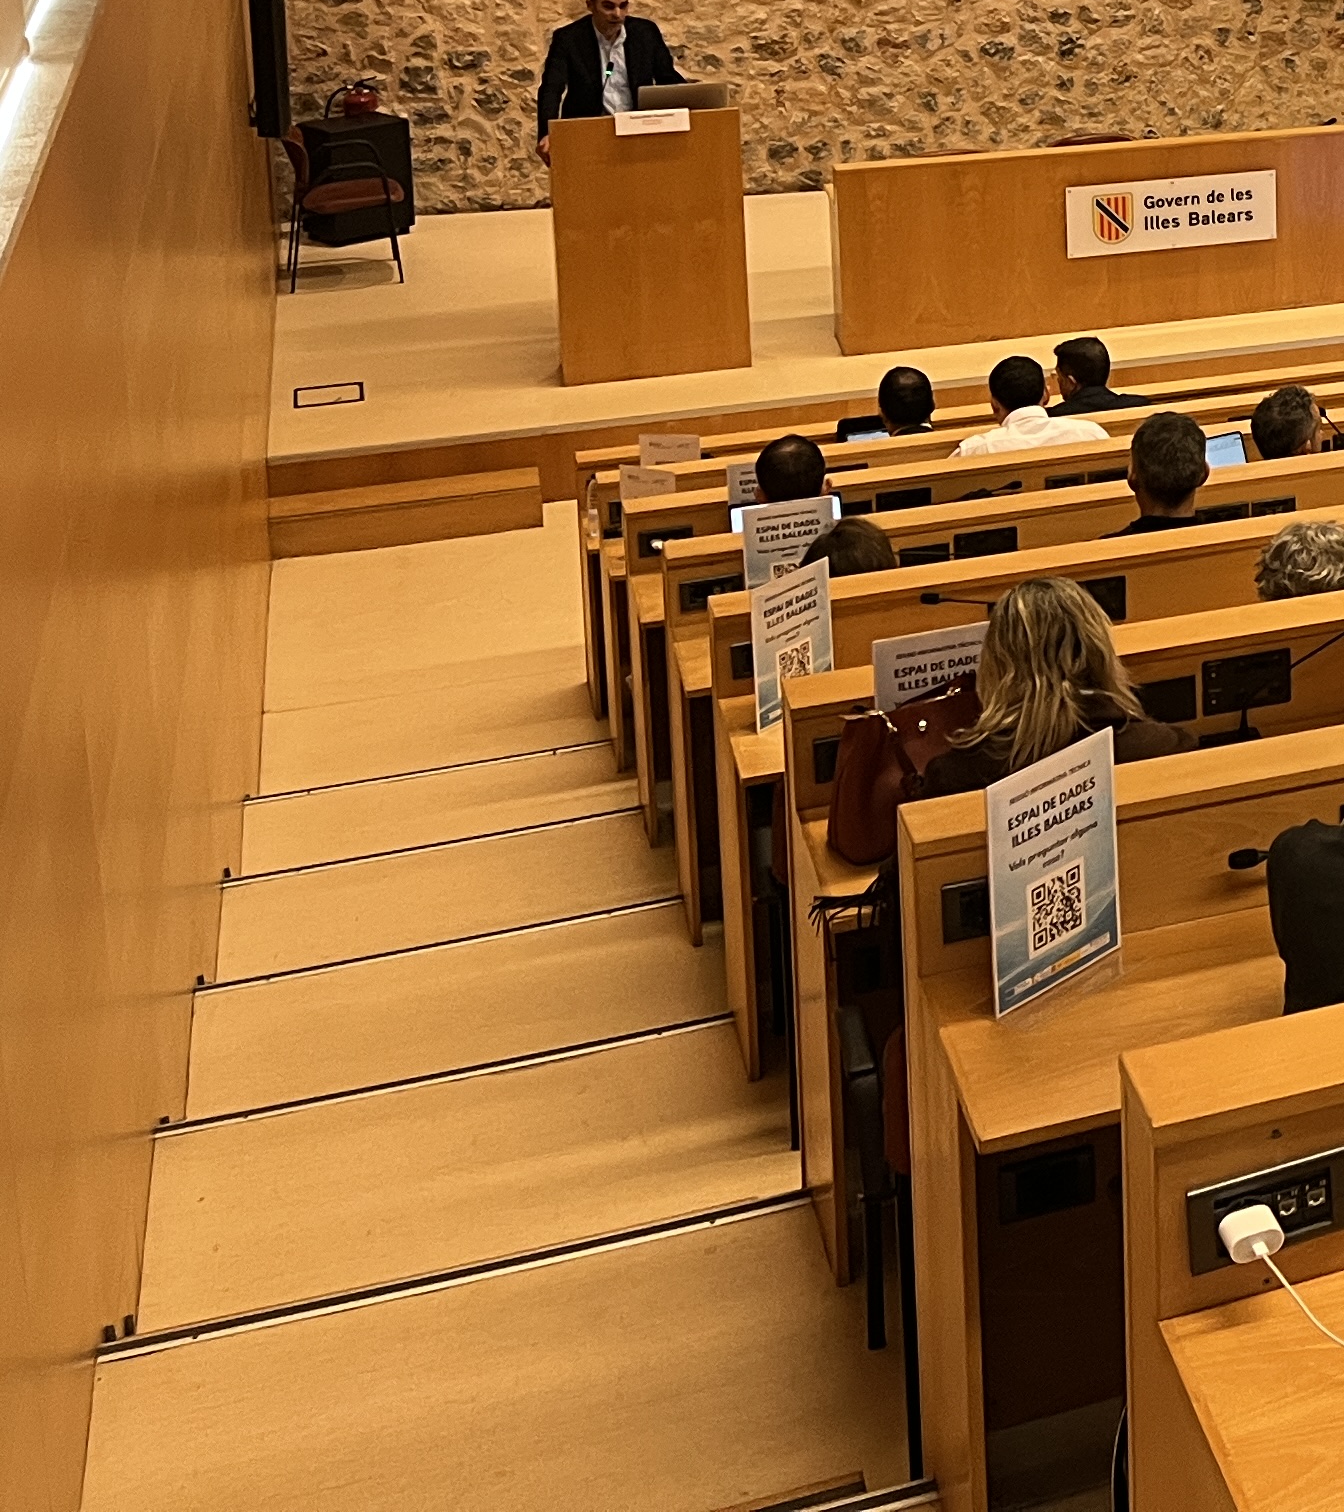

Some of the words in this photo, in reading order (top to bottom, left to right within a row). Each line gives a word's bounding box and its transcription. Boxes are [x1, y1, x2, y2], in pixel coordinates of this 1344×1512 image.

[1143, 195, 1201, 209] Govern
[1206, 190, 1225, 204] de
[1230, 188, 1253, 201] les
[1144, 215, 1181, 231] Illes
[1188, 210, 1254, 227] Balears
[894, 663, 927, 679] ESPAI
[930, 660, 946, 672] DE
[948, 654, 980, 668] DADE
[898, 677, 929, 692] ILLES
[1008, 805, 1040, 831] ESPAI
[1042, 795, 1057, 814] DE
[1059, 776, 1096, 805] DADES
[1012, 823, 1042, 848] ILLES
[1044, 796, 1094, 832] BALEARS
